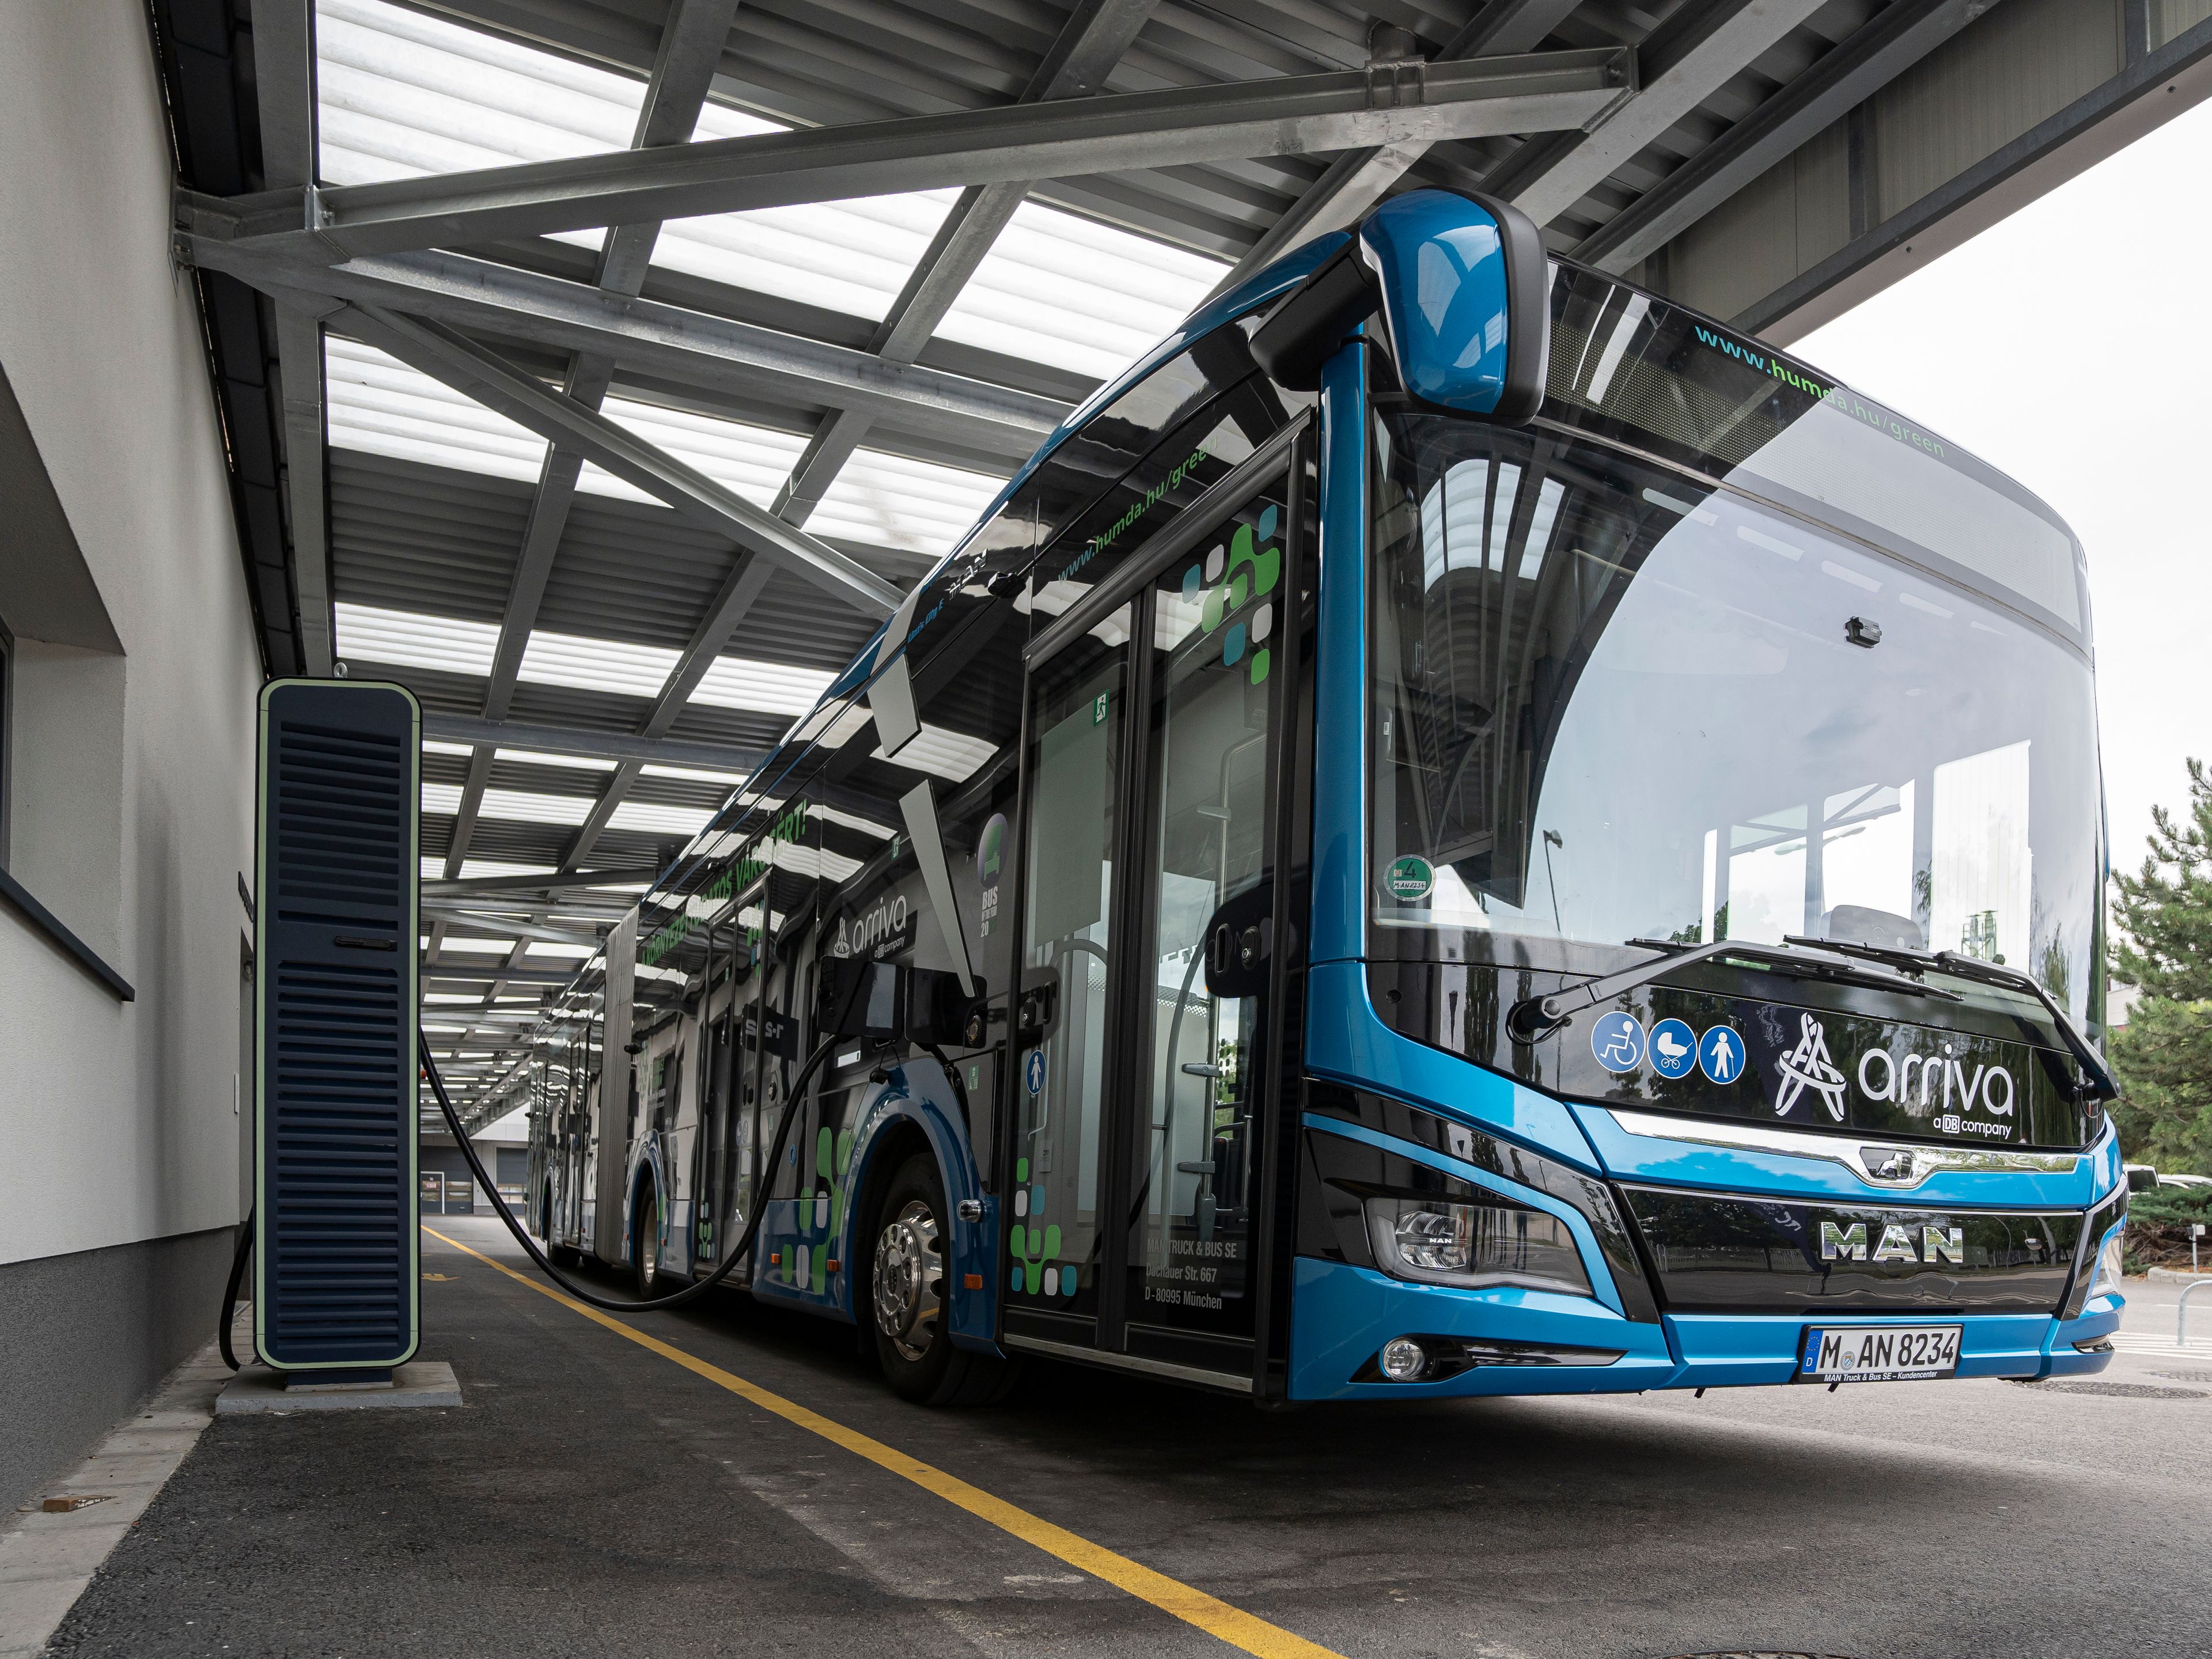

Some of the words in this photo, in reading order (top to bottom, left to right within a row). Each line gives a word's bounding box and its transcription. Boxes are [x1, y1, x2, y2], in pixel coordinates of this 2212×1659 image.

[1695, 325, 1944, 457] www.humda.hu/green
[1058, 434, 1218, 584] www.humda.hu/green
[1404, 861, 1416, 878] 4
[982, 885, 998, 910] BUS
[853, 895, 906, 953] arriva
[885, 936, 905, 953] company
[1858, 1044, 2013, 1116] arriva
[1933, 1118, 1941, 1129] a
[1944, 1115, 1959, 1132] DB
[1961, 1120, 2012, 1139] company
[1147, 1238, 1165, 1253] MAN
[1168, 1240, 1195, 1255] TRUCK
[1196, 1241, 1203, 1256] &
[1205, 1241, 1223, 1257] BUS
[1225, 1242, 1237, 1259] SE
[1820, 1222, 1963, 1264] MAN
[1146, 1262, 1184, 1280] Dachauer
[1185, 1265, 1199, 1282] Str.
[1200, 1267, 1218, 1283] 667
[1183, 1290, 1222, 1310] München
[1806, 1357, 1813, 1366] D
[1820, 1335, 1842, 1369] M
[1857, 1335, 1894, 1368] AN
[1898, 1332, 1956, 1366] 8234
[1824, 1373, 1841, 1381] MAN
[1843, 1373, 1861, 1381] Truck
[1897, 1370, 1938, 1380] Kundencenter
